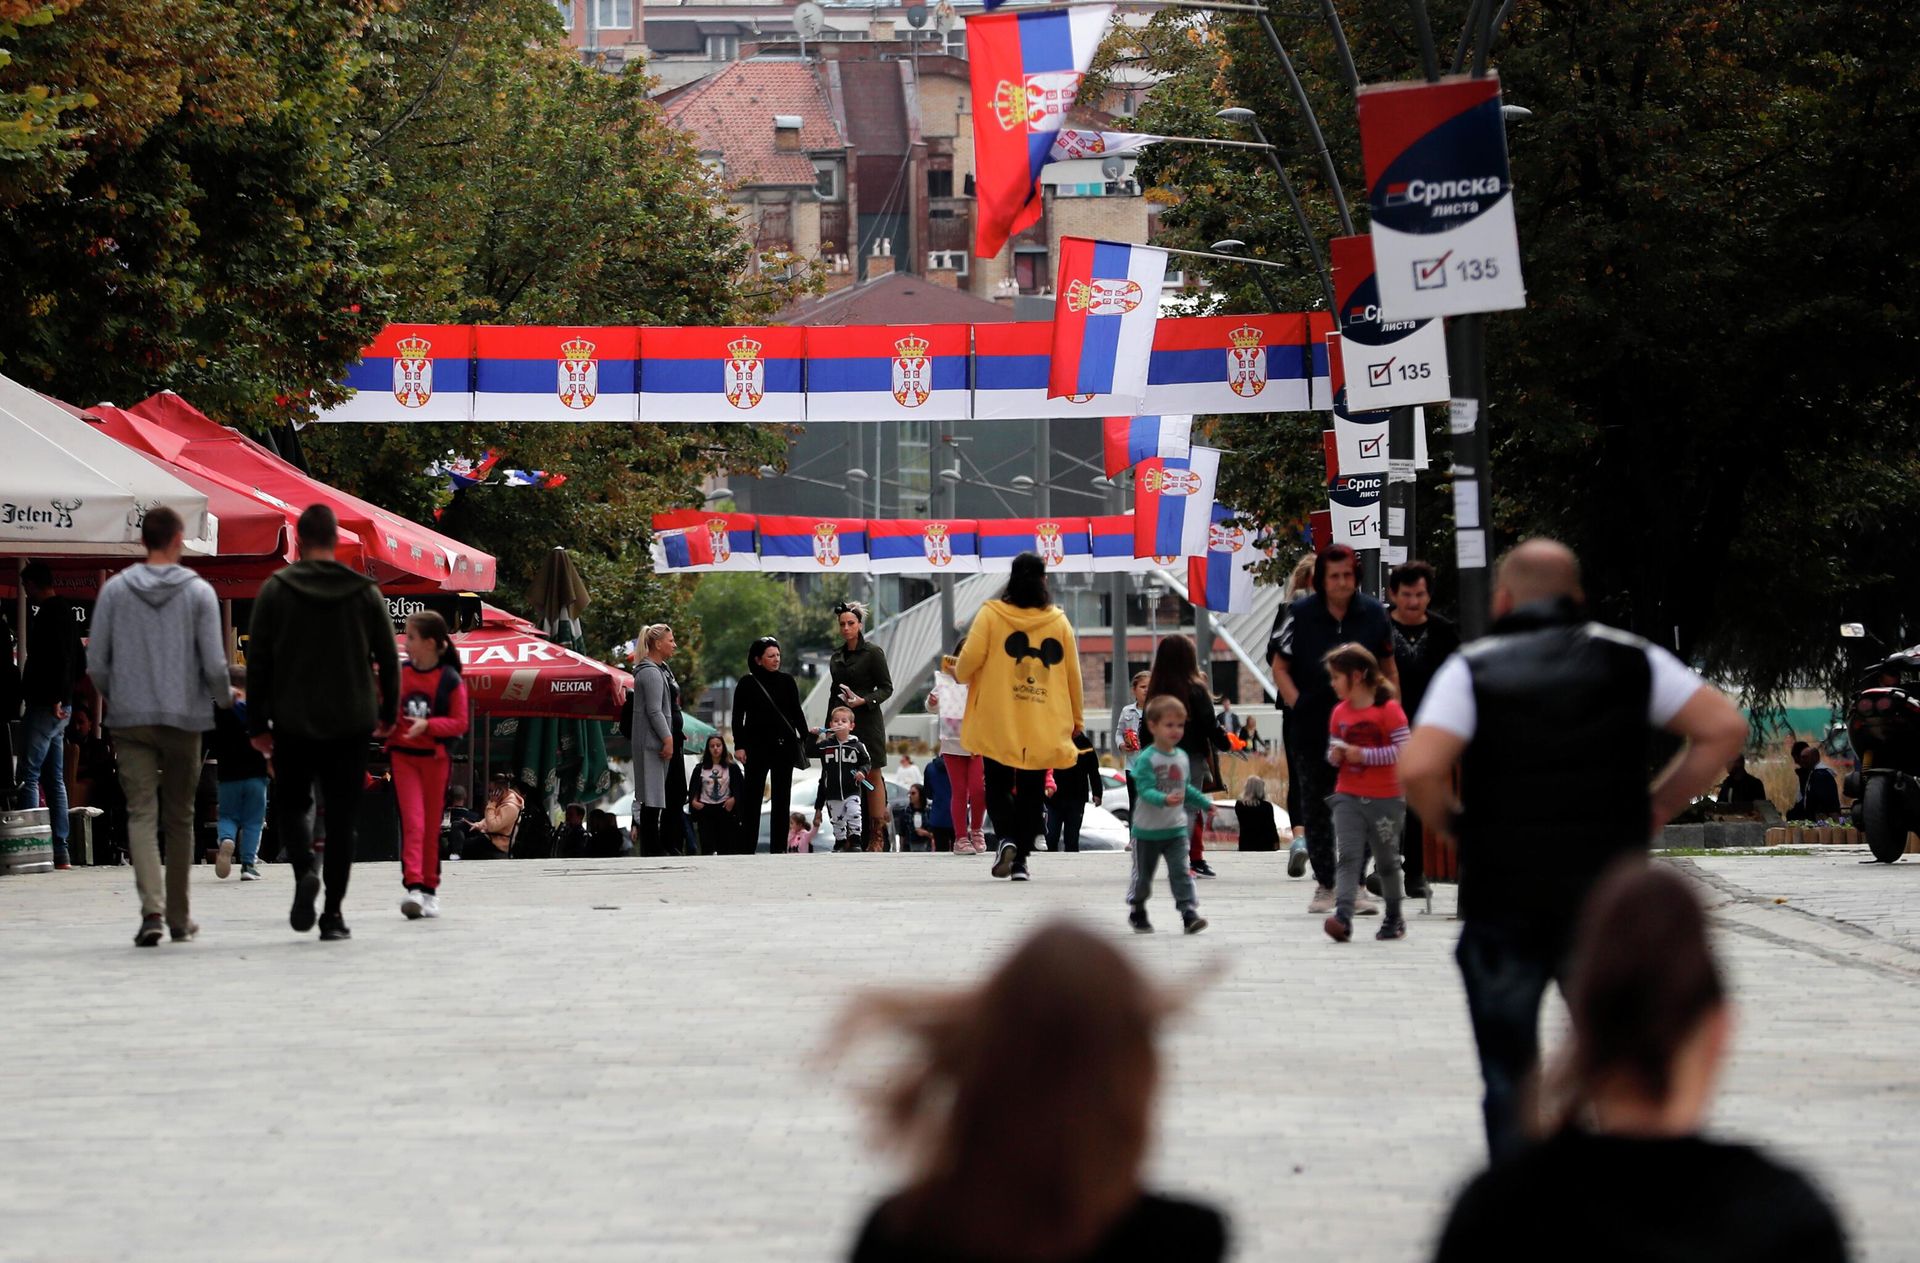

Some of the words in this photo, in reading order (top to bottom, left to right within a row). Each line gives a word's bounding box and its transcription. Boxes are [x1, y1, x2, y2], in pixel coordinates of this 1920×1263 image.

[1408, 176, 1501, 206] Српска
[1431, 201, 1479, 217] листа
[1457, 257, 1500, 281] 135
[1381, 320, 1416, 332] листа
[1399, 363, 1431, 381] 135
[1348, 478, 1381, 492] Српс
[1359, 490, 1380, 498] лист
[2, 503, 53, 523] Jelen
[457, 642, 557, 665] TAR
[551, 681, 592, 692] NEKTAR
[825, 748, 857, 763] FILA
